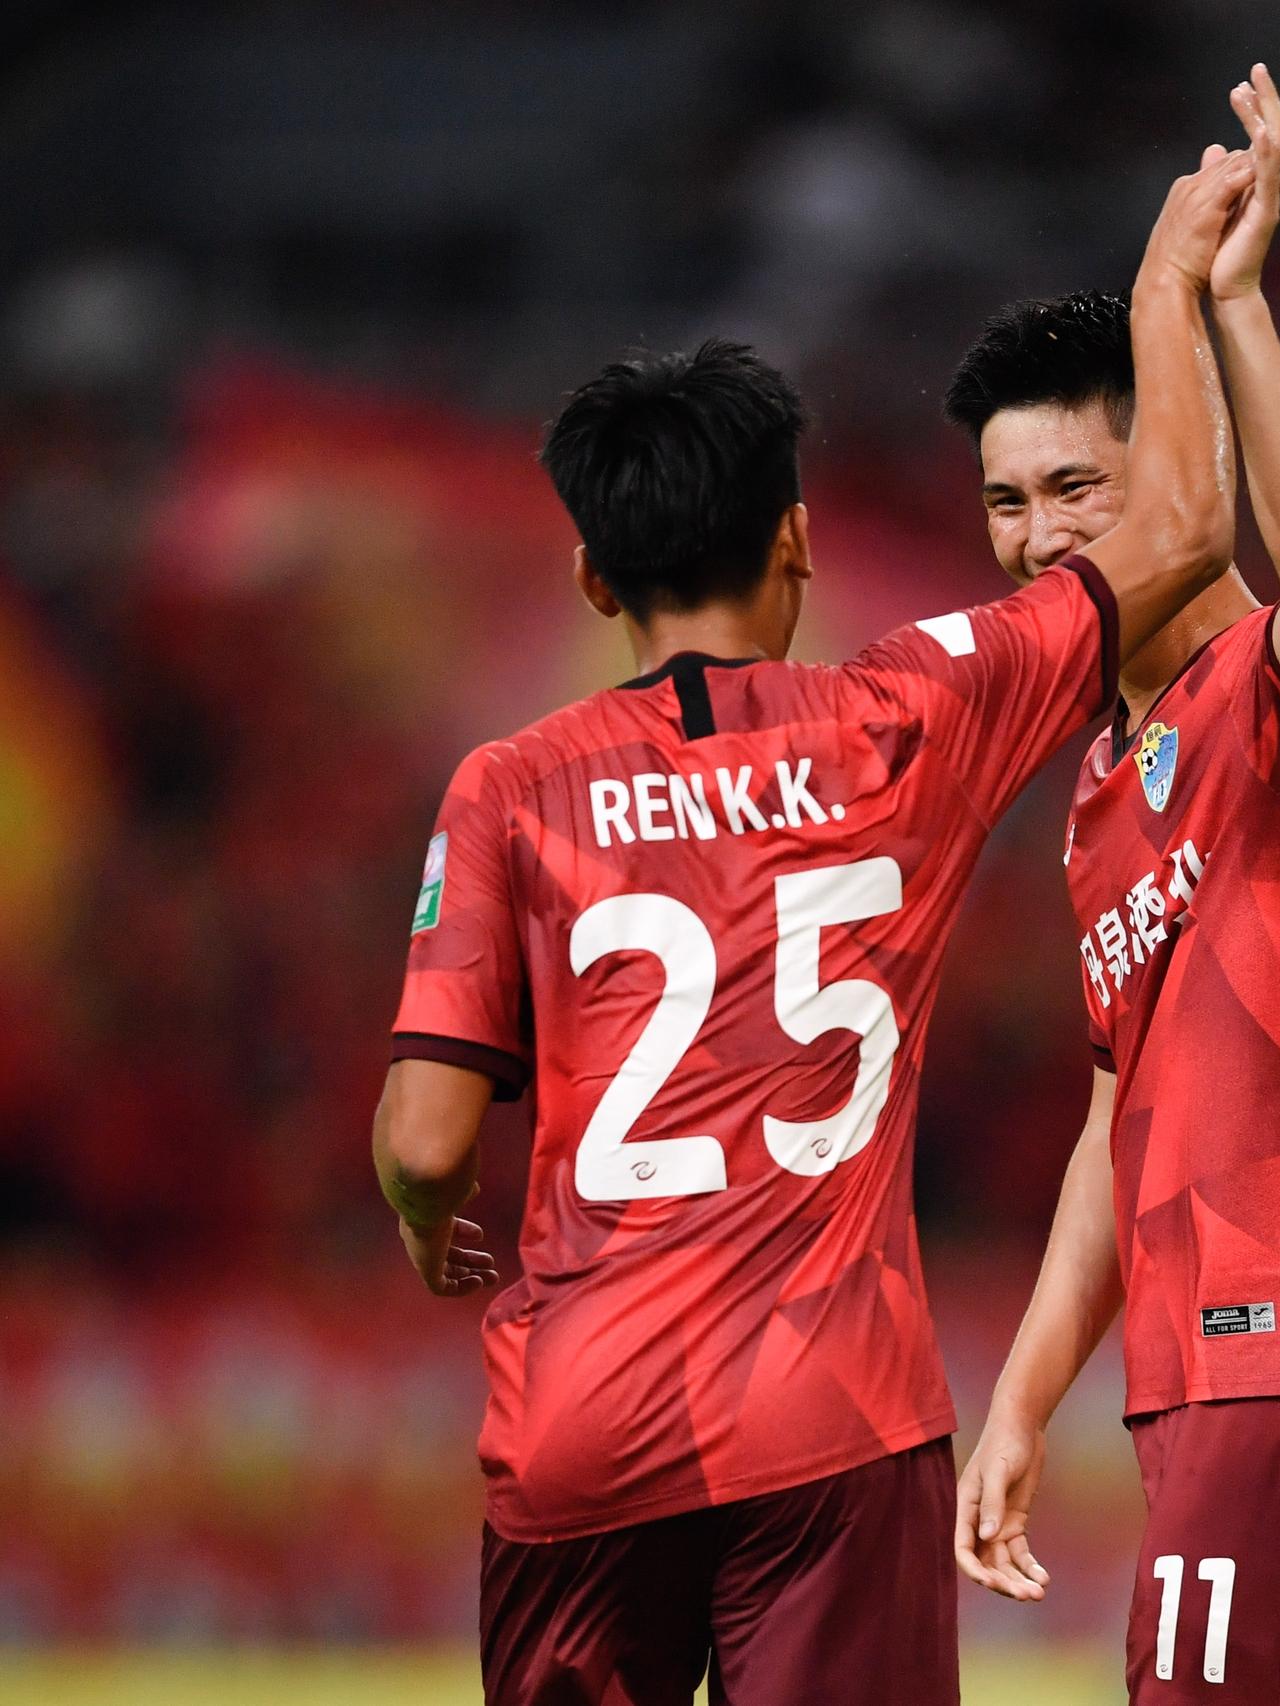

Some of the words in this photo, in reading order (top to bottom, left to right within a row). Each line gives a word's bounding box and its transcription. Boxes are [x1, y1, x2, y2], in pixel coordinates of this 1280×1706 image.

[589, 772, 718, 848] REN
[715, 757, 846, 836] K.K.
[569, 856, 902, 1202] 25
[1205, 1326, 1216, 1334] ALL
[1217, 1324, 1229, 1332] FOR
[1230, 1323, 1248, 1332] SPORT
[1153, 1554, 1236, 1684] 11
